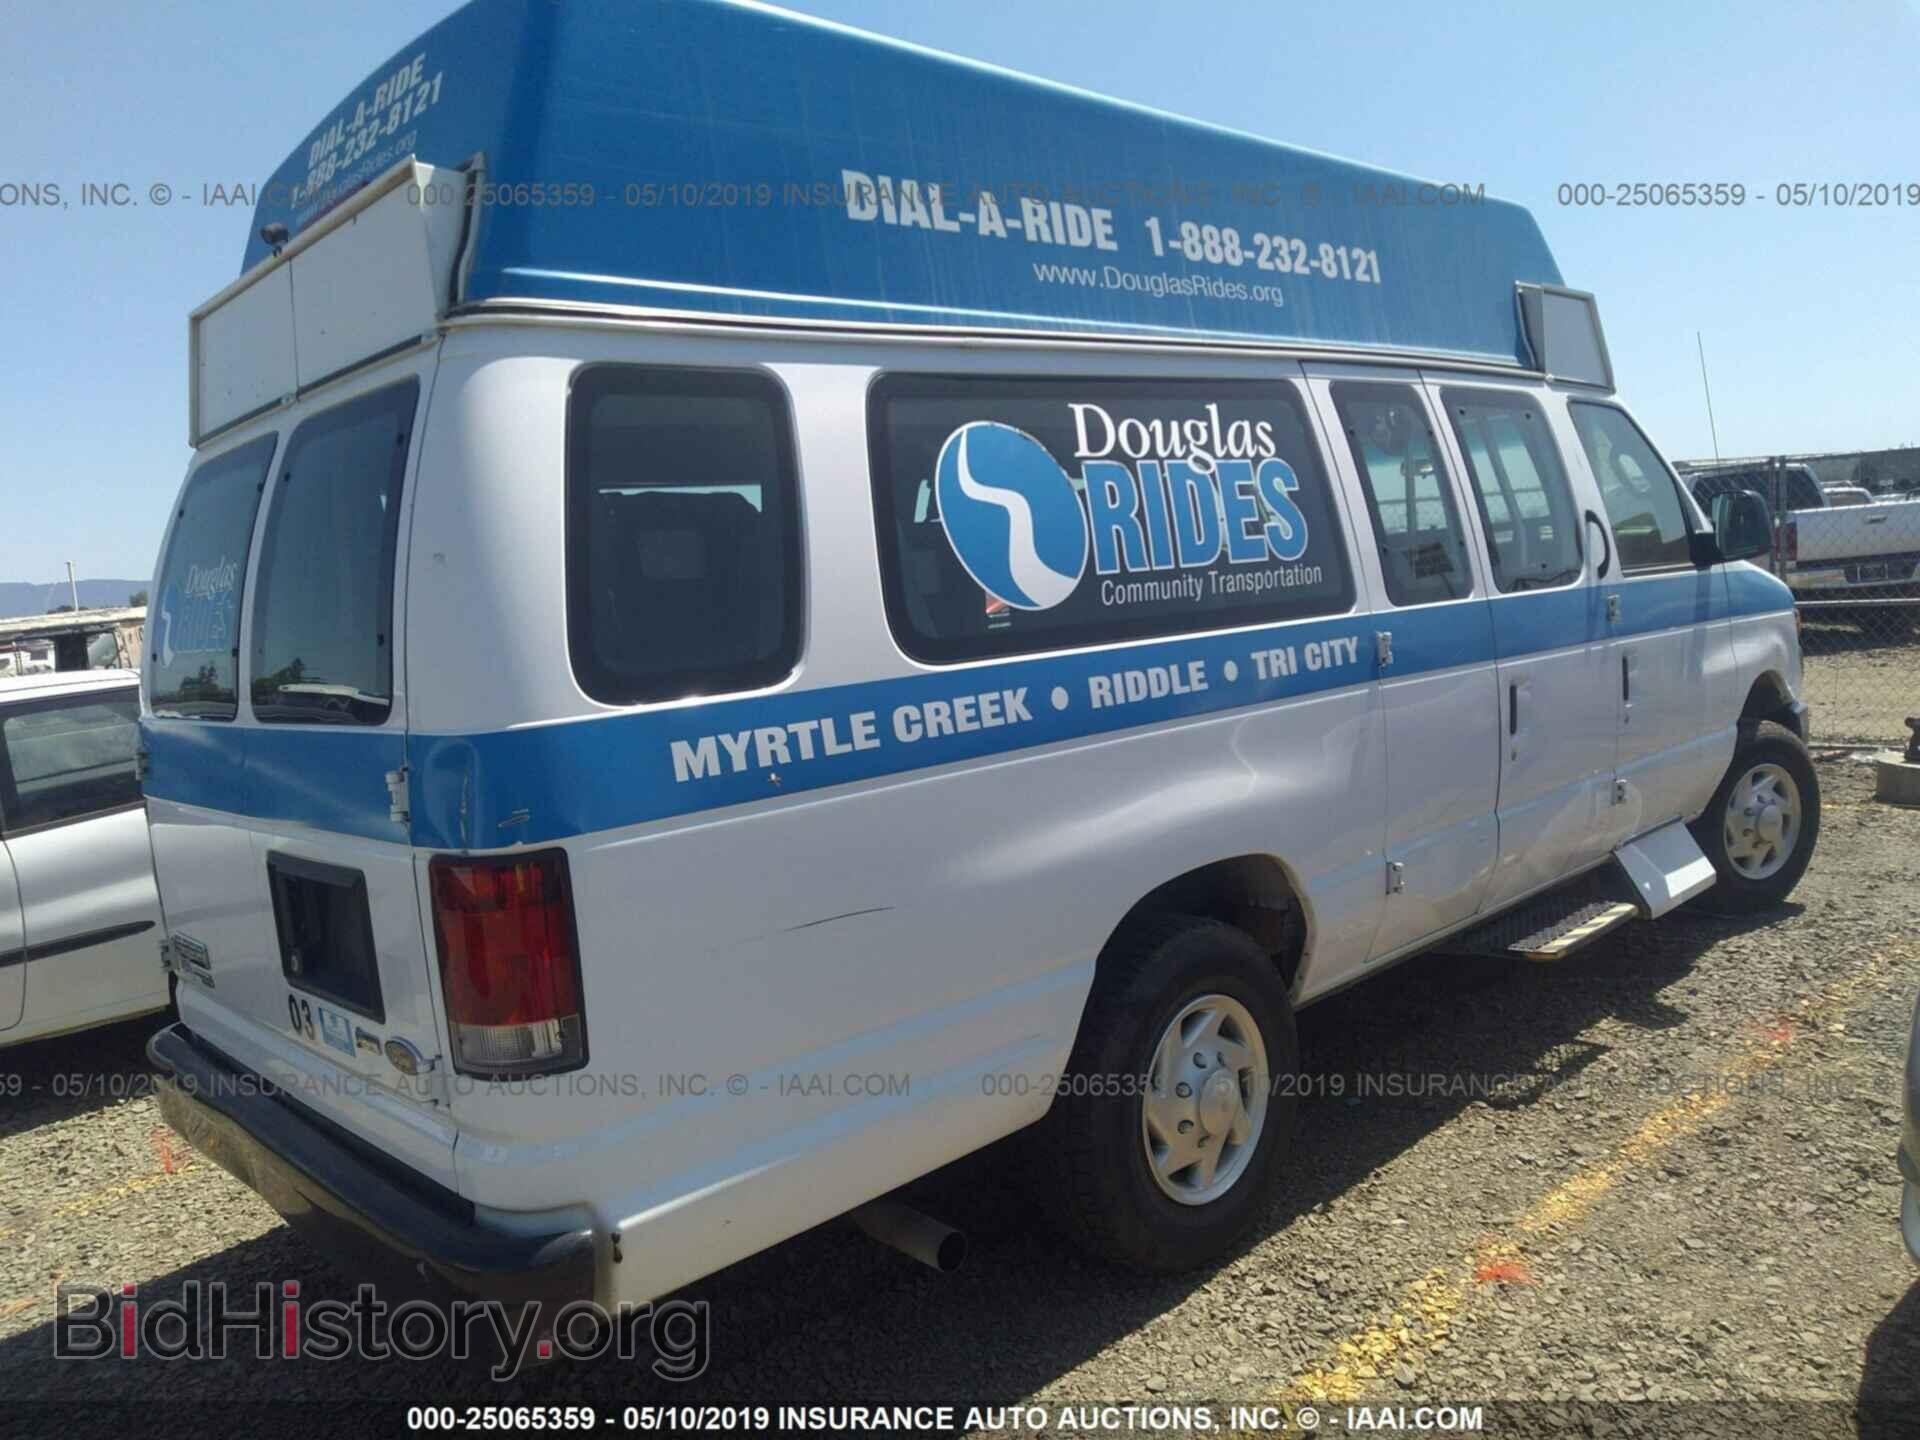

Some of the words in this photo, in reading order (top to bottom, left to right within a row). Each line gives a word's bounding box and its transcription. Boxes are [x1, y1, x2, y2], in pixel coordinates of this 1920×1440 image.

[307, 52, 426, 171] DIAL-A-RIDE
[842, 169, 1119, 251] DIAL-A-RIDE
[1144, 216, 1382, 285] 1-888-232-8121
[1032, 262, 1284, 307] www.DouglasRides.org
[1068, 403, 1276, 474] Douglas
[1080, 457, 1309, 575] RIDES
[1101, 573, 1202, 606] Community
[1208, 565, 1323, 595] Transportation
[671, 711, 881, 783] MYRTLE
[893, 686, 1034, 744] CREEK
[1088, 659, 1209, 709] RIDDLE
[1251, 650, 1298, 681] TRI
[1304, 637, 1361, 671] CITY
[288, 994, 315, 1041] 03
